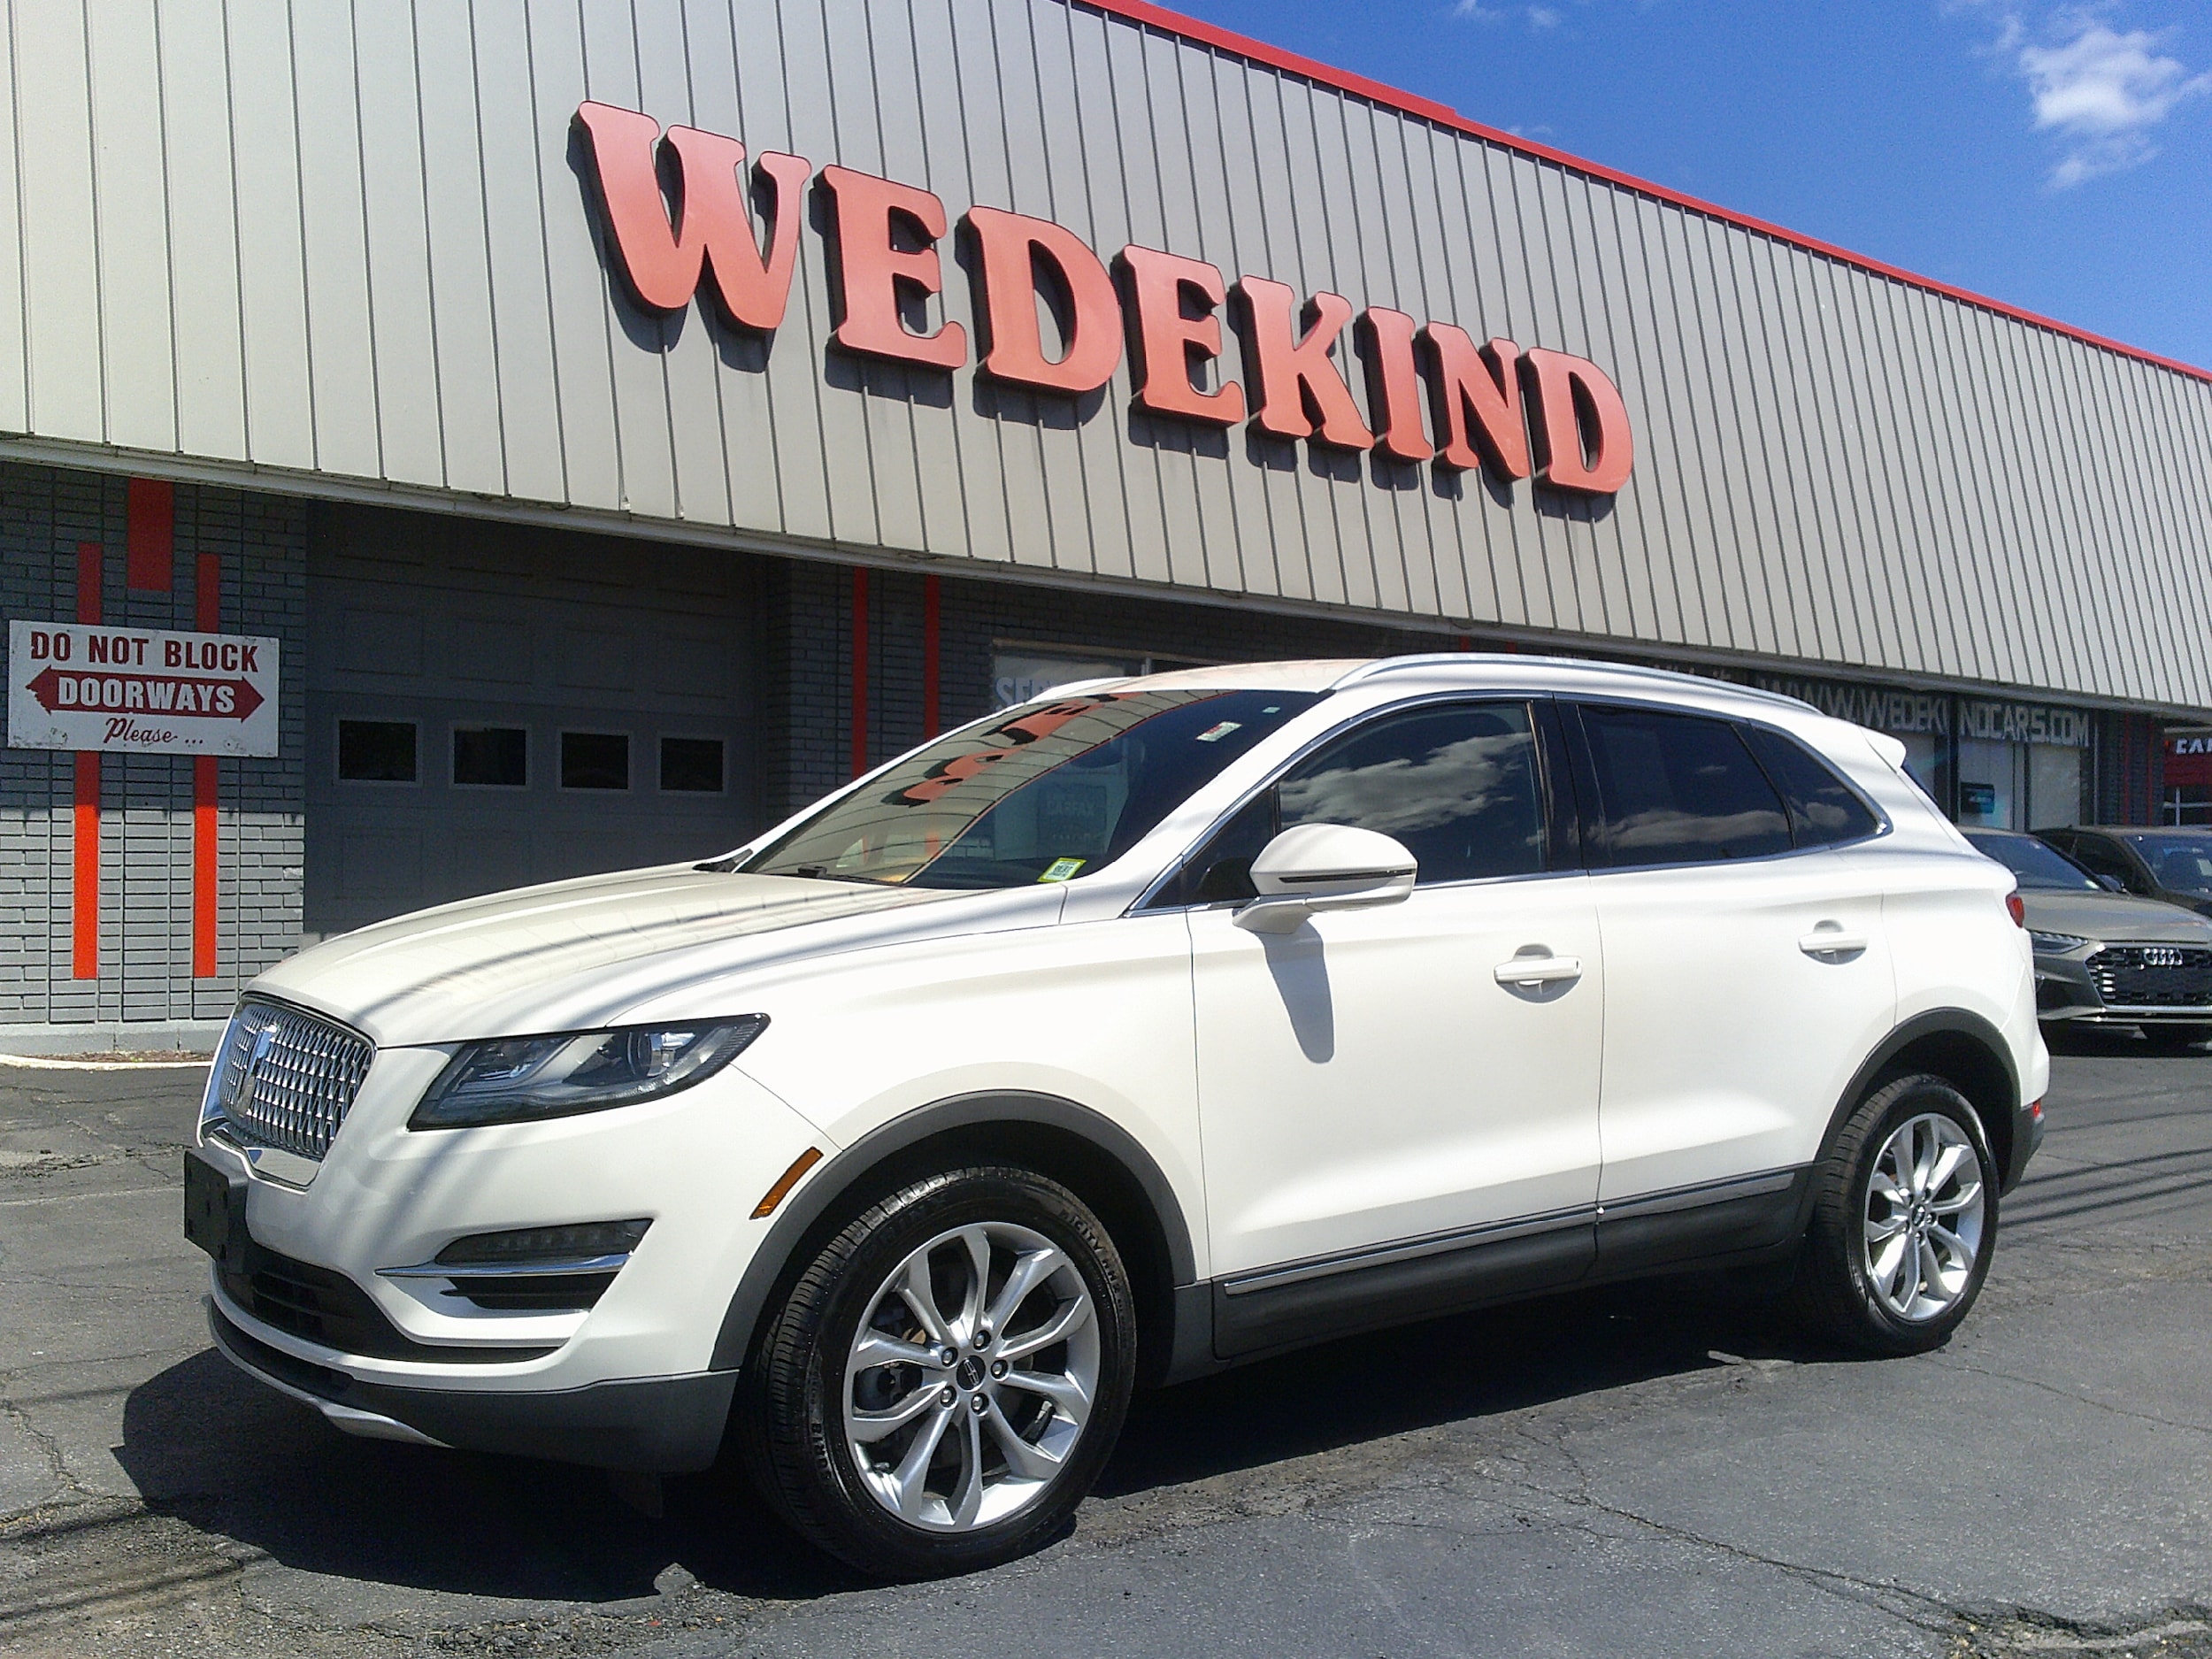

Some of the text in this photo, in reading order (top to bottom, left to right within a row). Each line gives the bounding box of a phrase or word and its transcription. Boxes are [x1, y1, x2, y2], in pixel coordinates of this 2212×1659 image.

[577, 99, 1634, 494] WEDEKIND
[30, 631, 258, 672] DO NOT BLOCK
[58, 676, 235, 714] DOORWAYS
[103, 718, 178, 744] Please
